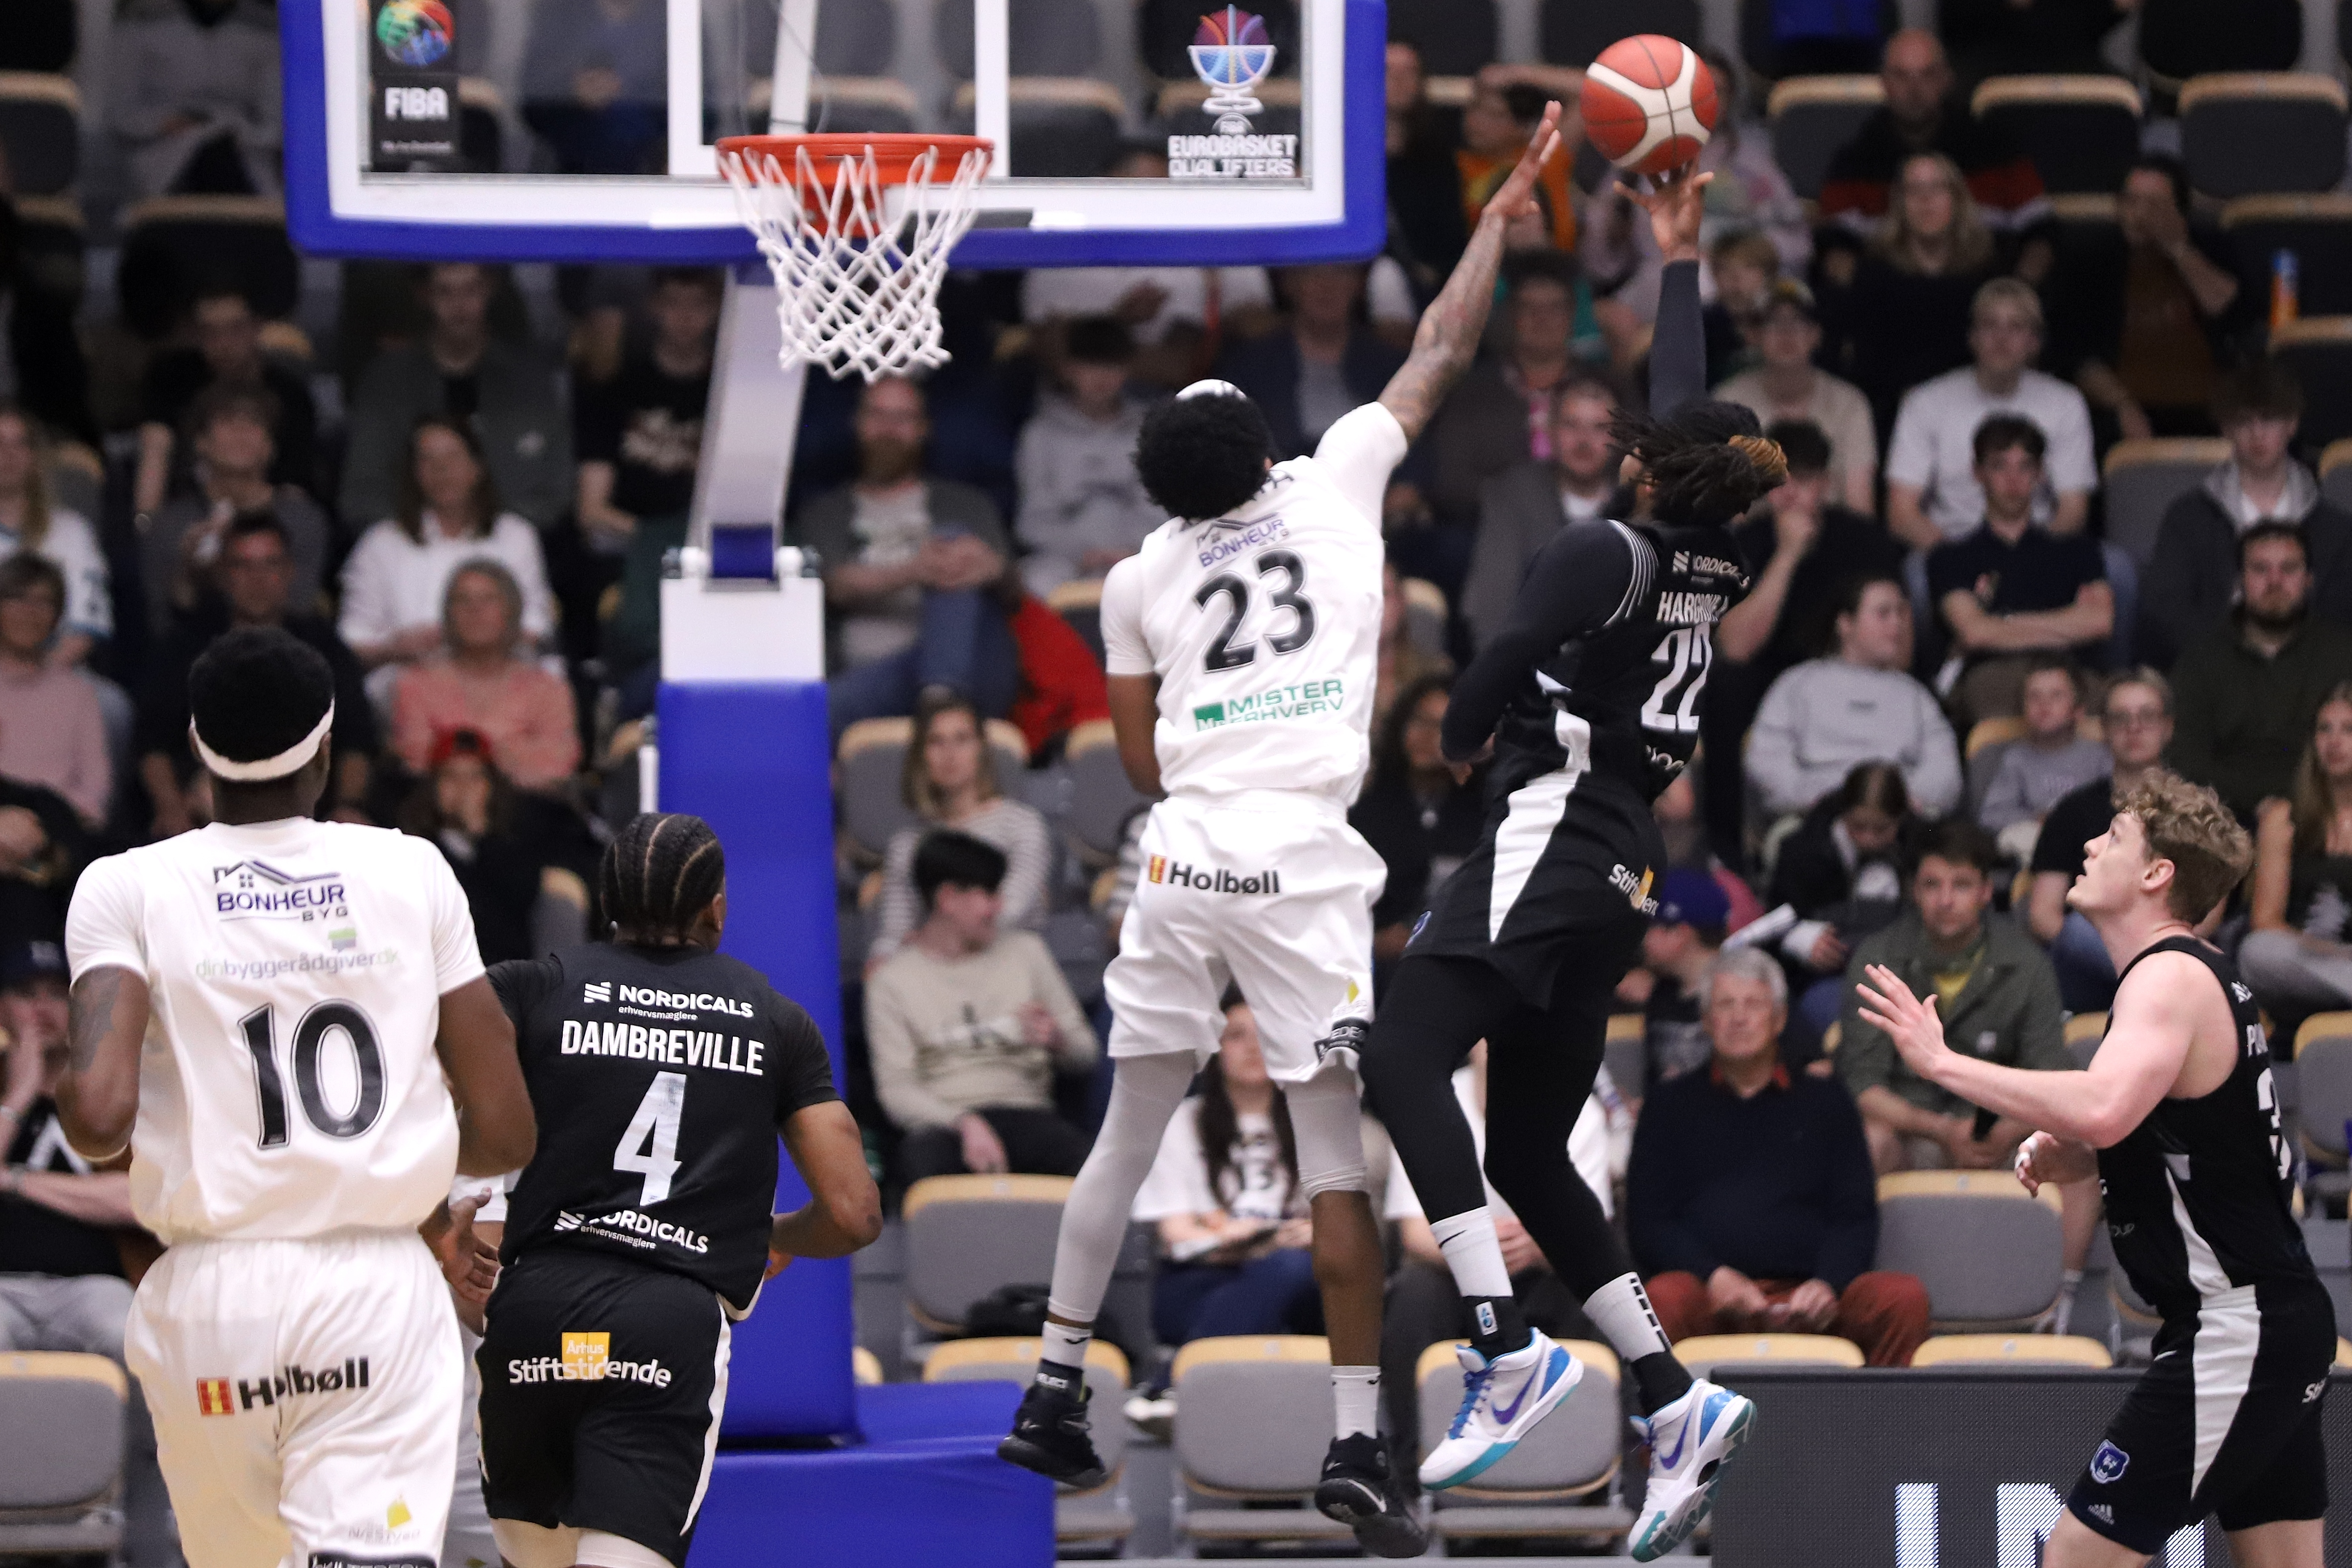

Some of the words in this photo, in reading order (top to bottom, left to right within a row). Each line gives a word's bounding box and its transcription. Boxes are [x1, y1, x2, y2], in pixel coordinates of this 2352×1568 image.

[385, 86, 449, 120] FIBA
[1168, 134, 1297, 158] EUROBASKET
[1168, 158, 1295, 178] QUALIFIERS
[1199, 519, 1285, 567] BONHEUR
[1193, 547, 1319, 674] 23
[1641, 622, 1712, 732] 22
[1228, 679, 1343, 715] MISTER
[1169, 861, 1280, 894] Holbøll
[217, 883, 345, 912] BONHEUR
[302, 906, 348, 922] BYG
[196, 946, 399, 980] dinbyggerådgiver.dk
[618, 984, 754, 1019] NORDICALS
[618, 1004, 698, 1022] erhvervsmæglere
[561, 1019, 765, 1076] DAMBREVILLE
[237, 998, 388, 1150] 10
[613, 1070, 687, 1207] 4
[580, 1225, 657, 1250] erhvervsmæglere
[589, 1209, 710, 1254] ORDICALS
[238, 1356, 369, 1410] Holbøll
[508, 1355, 672, 1390] Stiftstidende
